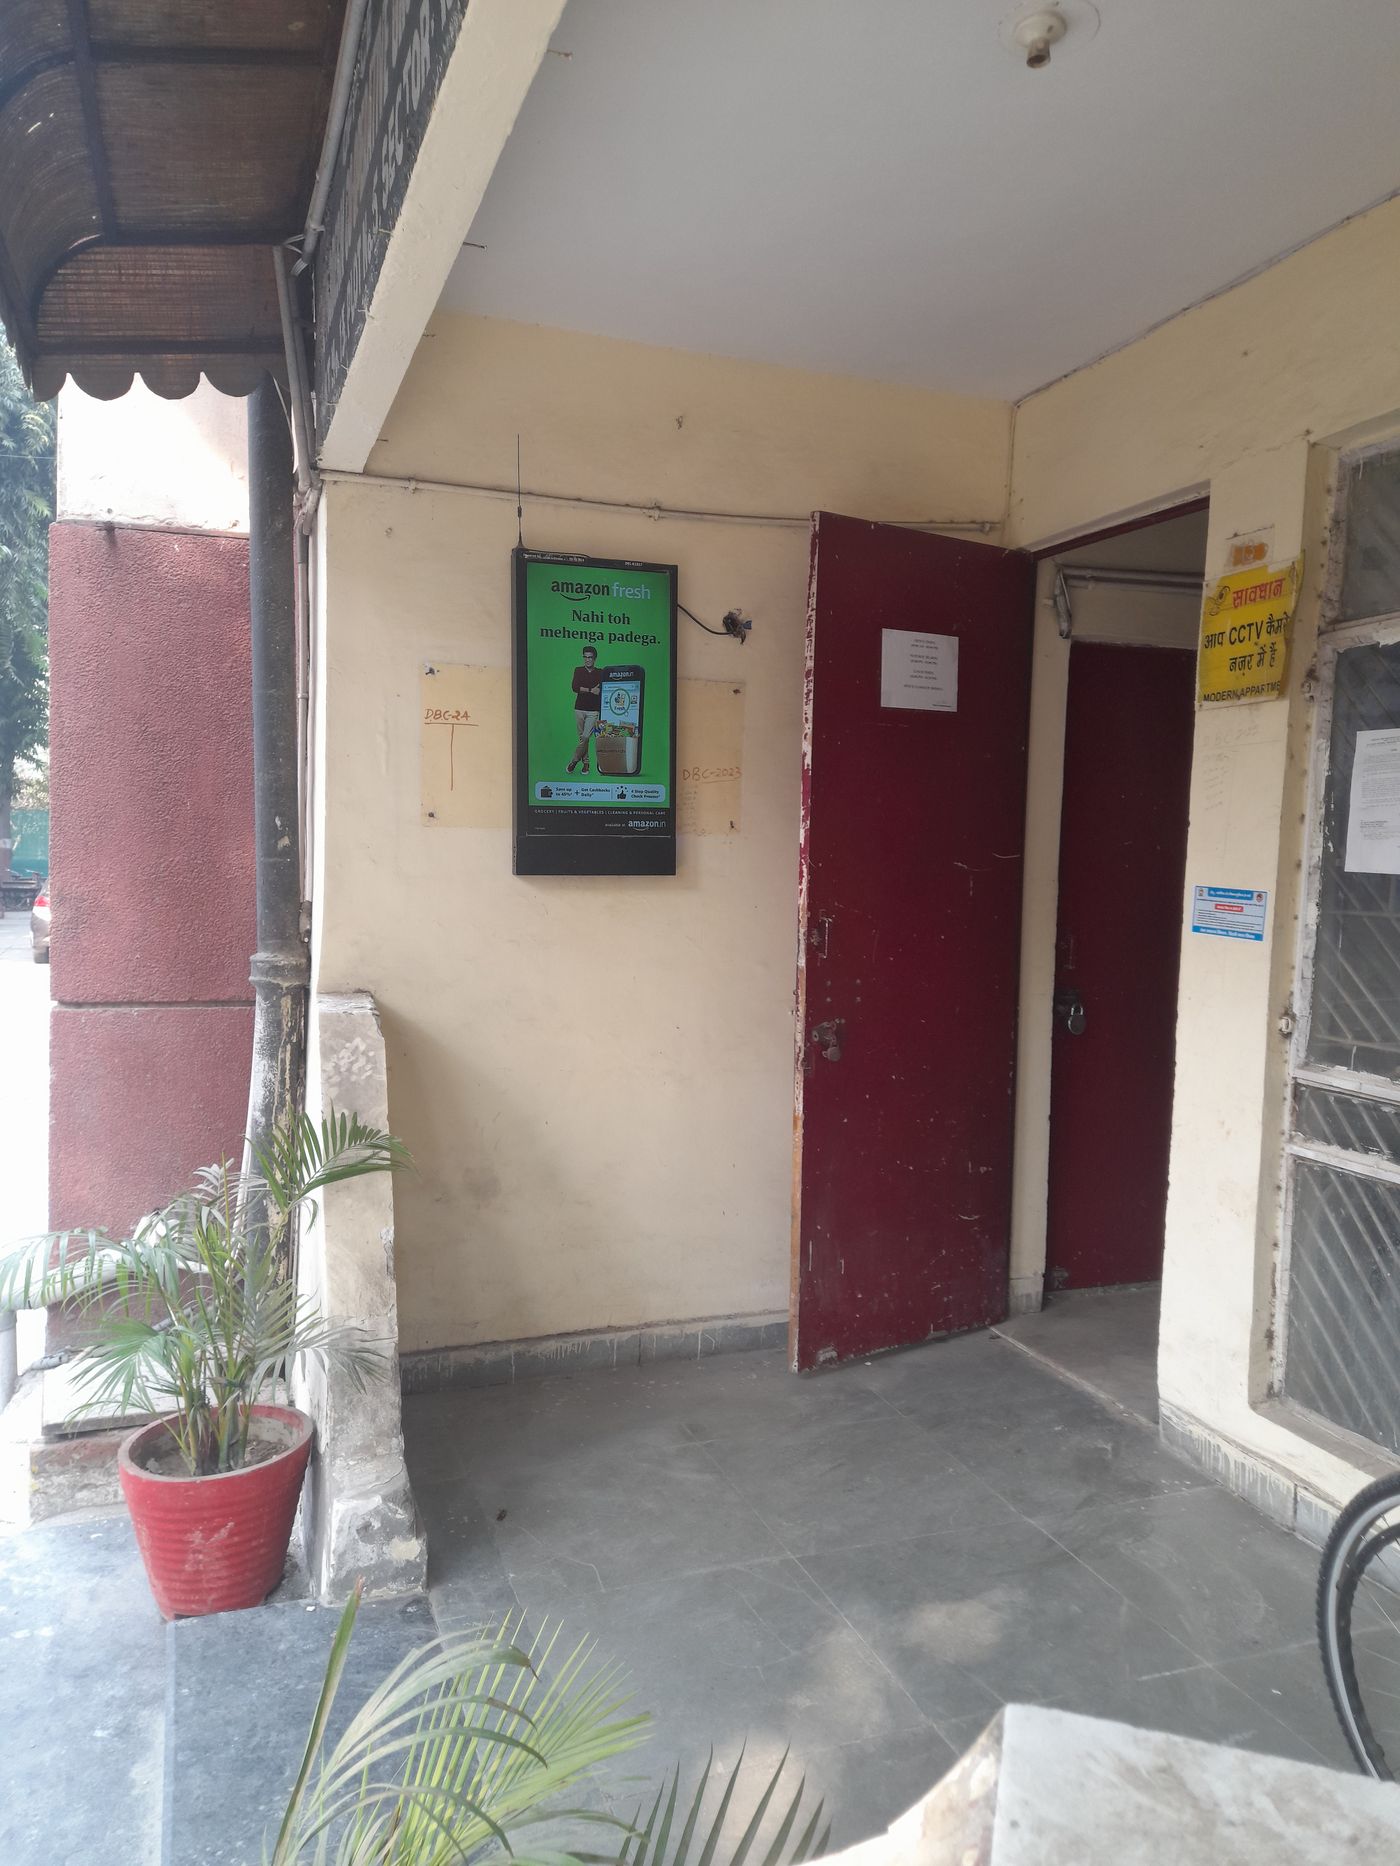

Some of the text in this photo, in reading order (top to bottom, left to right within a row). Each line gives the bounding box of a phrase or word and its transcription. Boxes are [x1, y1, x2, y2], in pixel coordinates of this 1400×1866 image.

[551, 580, 651, 600] amazon fresh
[1232, 577, 1286, 609] सावधान
[571, 609, 631, 625] Nahi toh
[540, 627, 661, 646] mehenga padega.
[1204, 631, 1226, 649] आप
[1228, 620, 1264, 646] CCTV
[1256, 645, 1267, 669] में
[1202, 689, 1238, 702] MODERN
